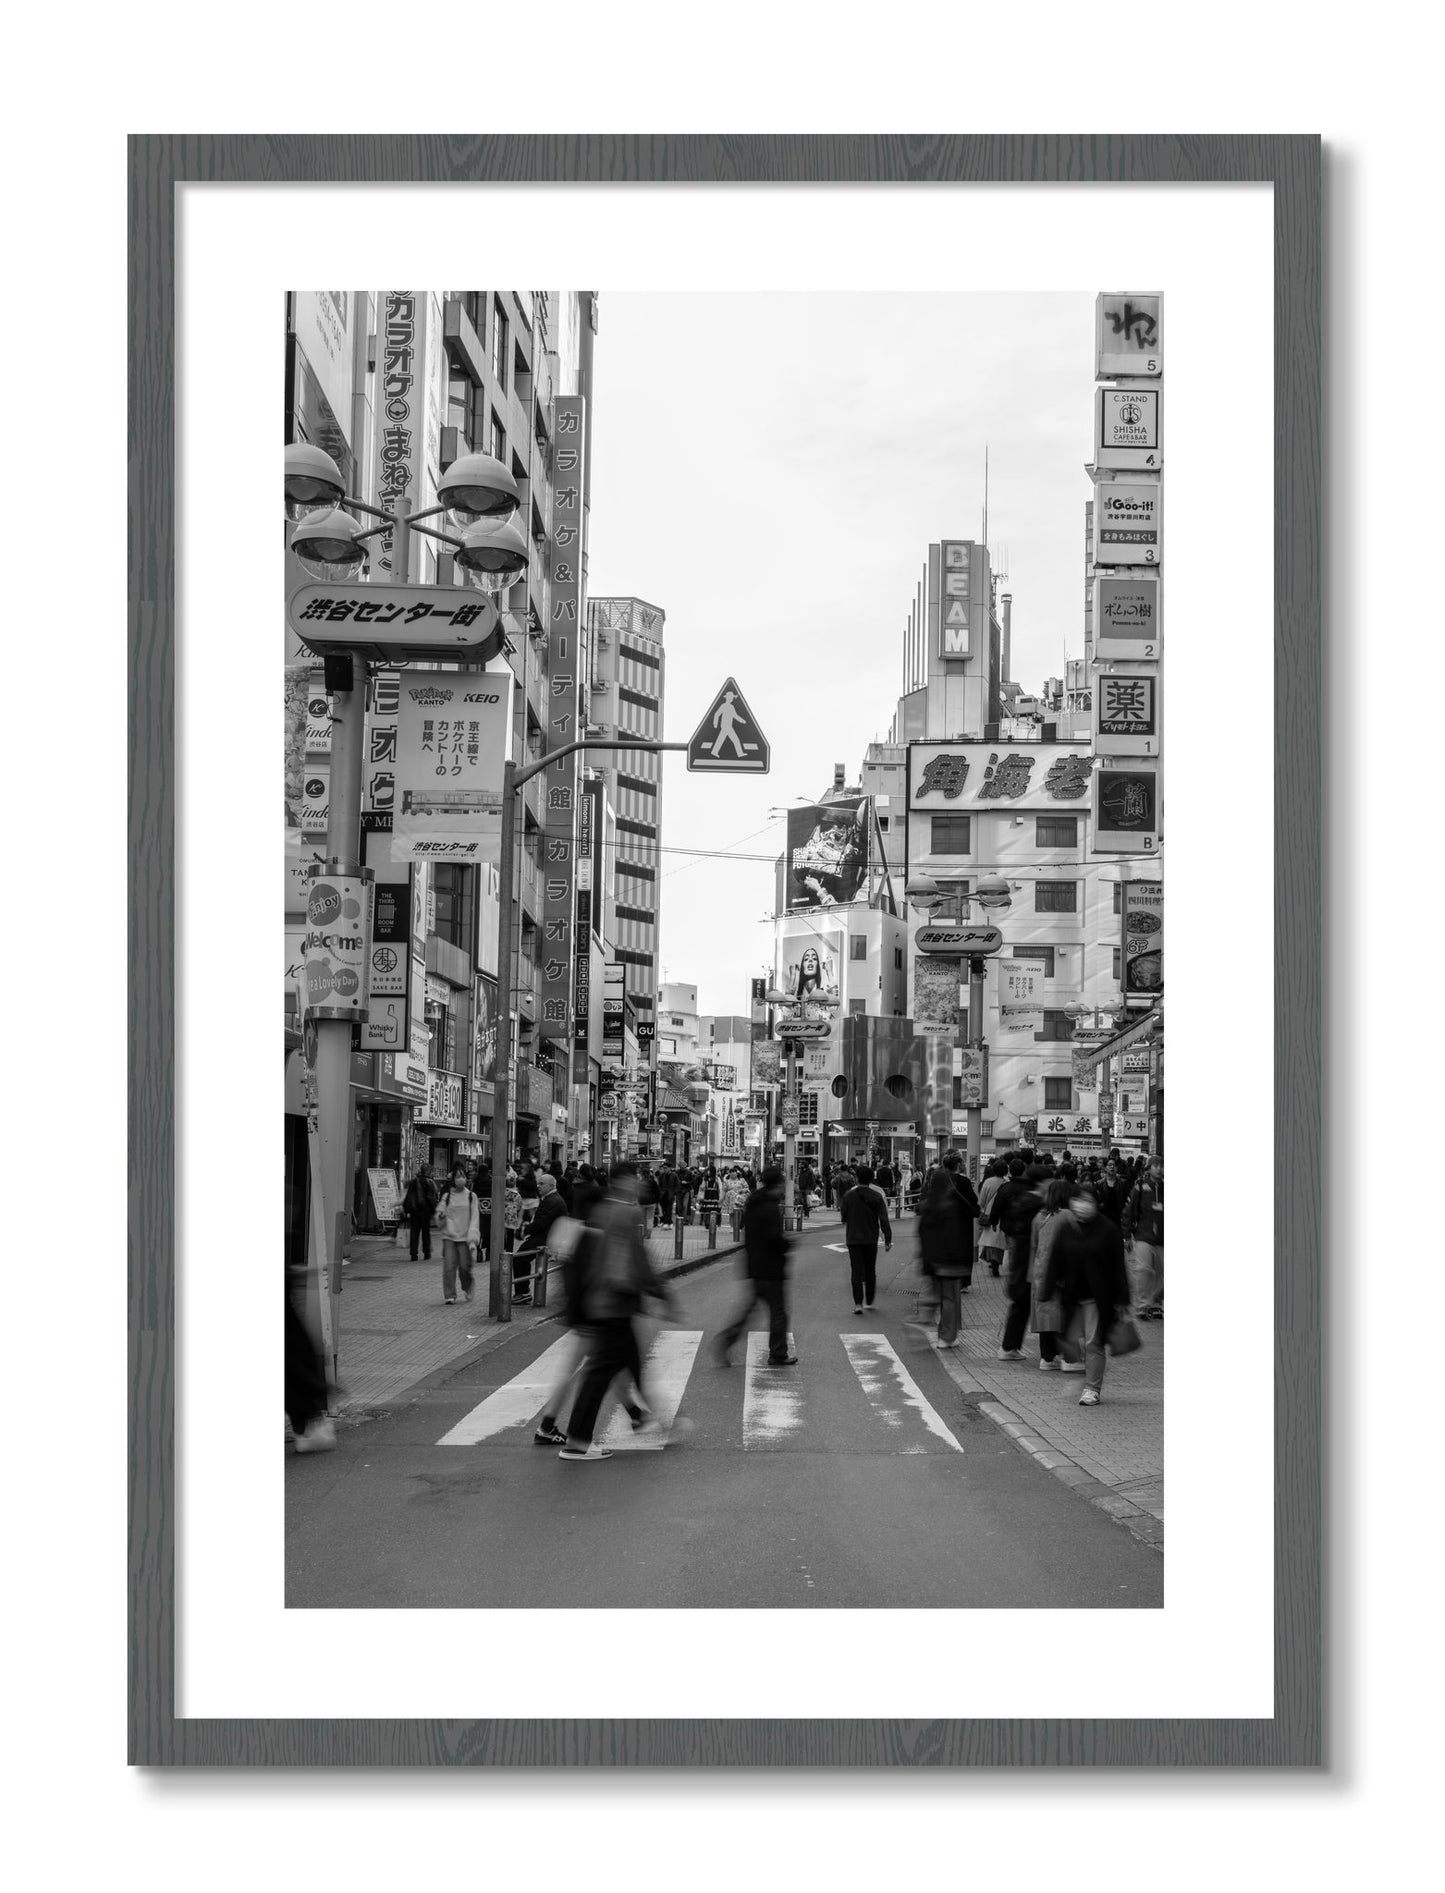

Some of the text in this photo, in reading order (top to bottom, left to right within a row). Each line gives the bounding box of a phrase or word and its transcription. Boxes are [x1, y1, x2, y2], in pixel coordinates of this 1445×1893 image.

[1147, 360, 1156, 371] 5
[1113, 426, 1147, 434] SHISHA
[1146, 454, 1155, 466] 4
[1113, 499, 1153, 511] Goo-it!
[1145, 549, 1154, 561] 3
[945, 544, 969, 652] BEAM
[299, 598, 486, 626] 渋谷センター街
[1145, 645, 1154, 657] 2
[463, 693, 500, 704] KEIO
[1107, 681, 1145, 719] 薬
[422, 720, 434, 752] 冒険へ
[436, 720, 449, 776] カントーの
[451, 720, 464, 776] ポケパーク
[468, 721, 480, 765] 京王線で
[1144, 741, 1151, 752] 1
[915, 753, 1094, 799] 角海老
[412, 842, 479, 852] 渋谷センター街
[1144, 837, 1152, 849] B
[544, 840, 570, 1021] カラオケ館
[920, 932, 998, 943] 渋谷センター街
[1127, 940, 1148, 954] 6F
[369, 1024, 394, 1032] Whisky
[639, 1026, 654, 1035] GU
[1047, 1116, 1092, 1132] 兆楽
